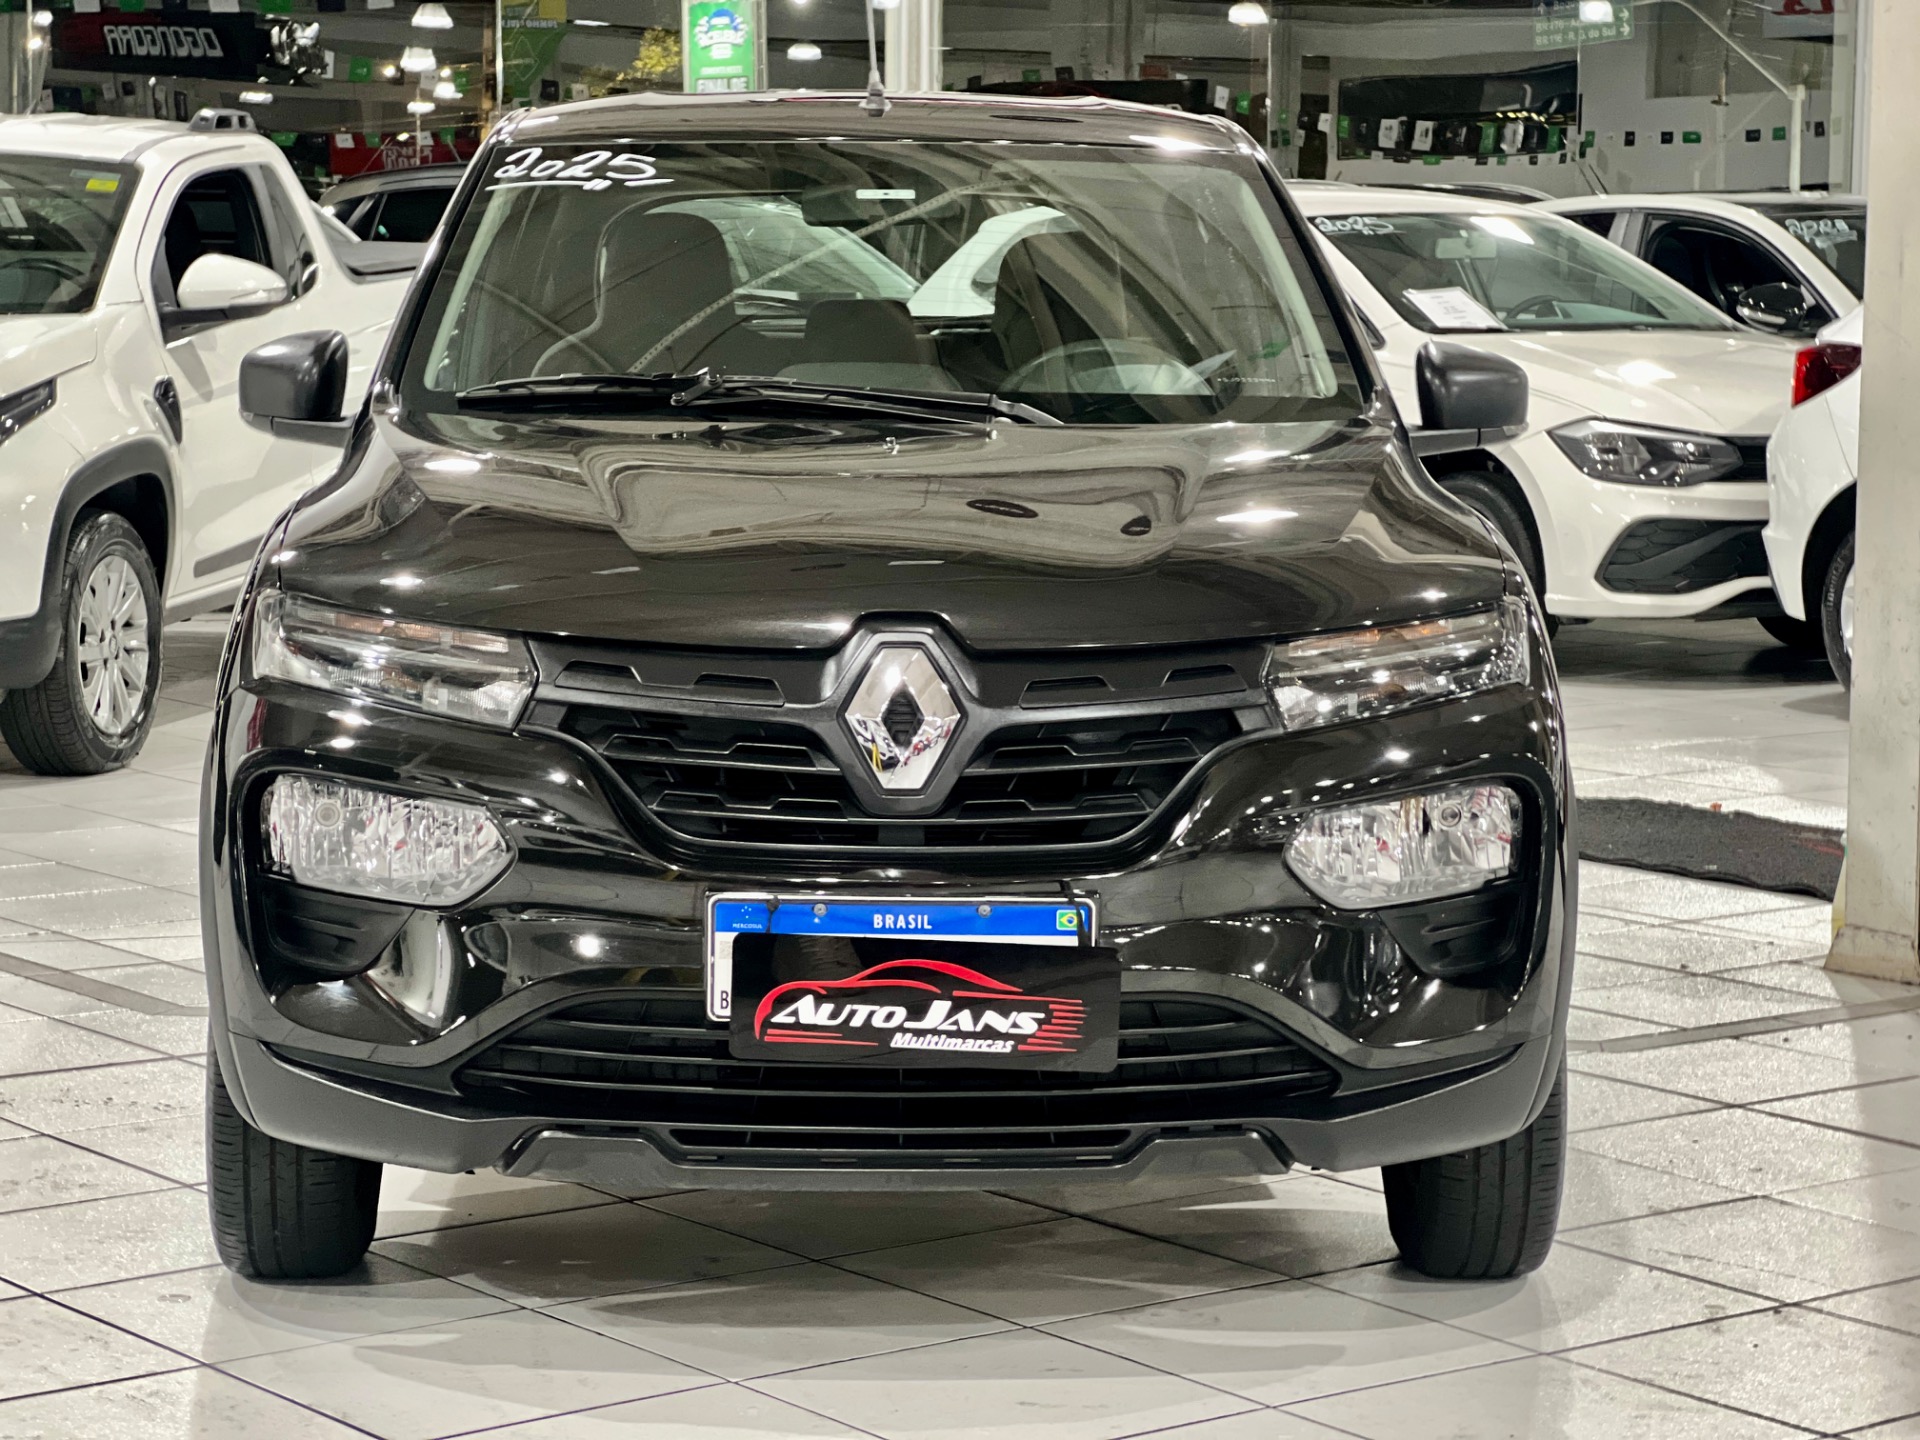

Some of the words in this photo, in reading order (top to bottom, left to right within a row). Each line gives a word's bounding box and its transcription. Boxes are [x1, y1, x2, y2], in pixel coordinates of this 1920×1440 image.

[494, 147, 656, 180] 2025
[1314, 216, 1394, 235] 2025
[873, 913, 933, 930] BRASIL
[770, 994, 897, 1028] AUTO
[906, 999, 1046, 1035] JANS
[890, 1032, 1015, 1053] Multimarcas
